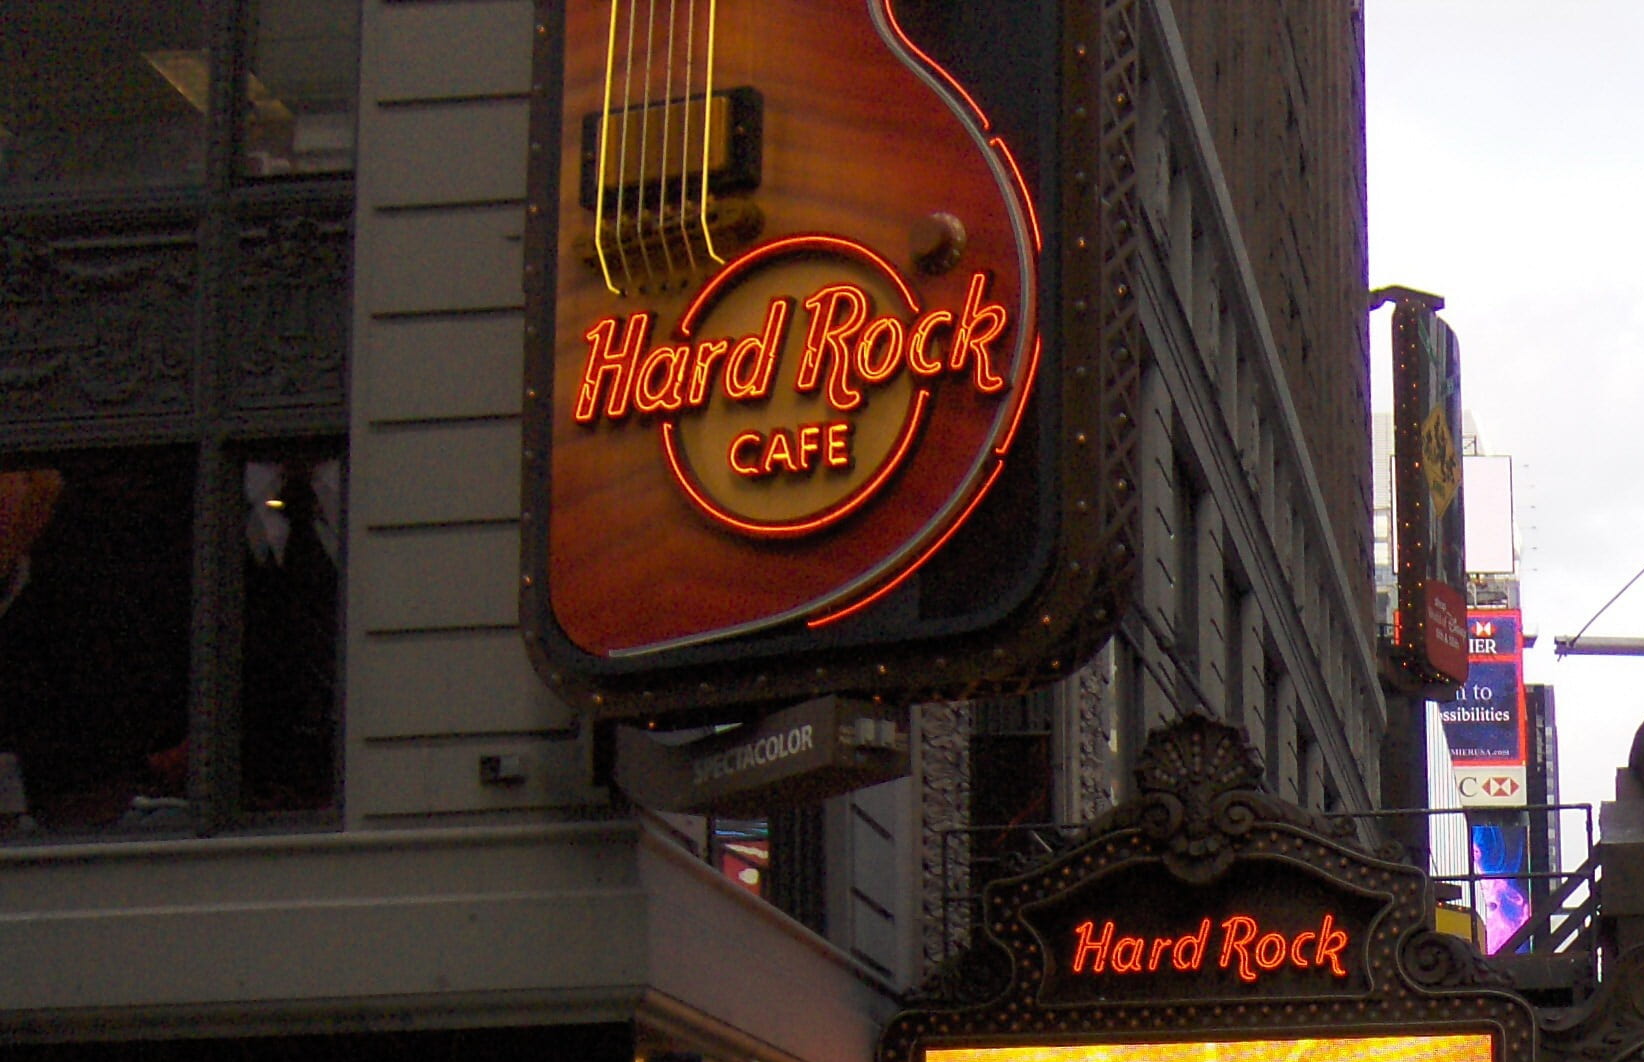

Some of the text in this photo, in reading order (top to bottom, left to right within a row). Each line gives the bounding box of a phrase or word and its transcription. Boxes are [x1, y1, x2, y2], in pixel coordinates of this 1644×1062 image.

[573, 272, 1006, 424] Hard Rock
[727, 422, 851, 476] CAFE
[1473, 683, 1493, 700] to
[693, 723, 815, 785] SPECTACOLOR
[1071, 913, 1349, 982] Hard Rock
